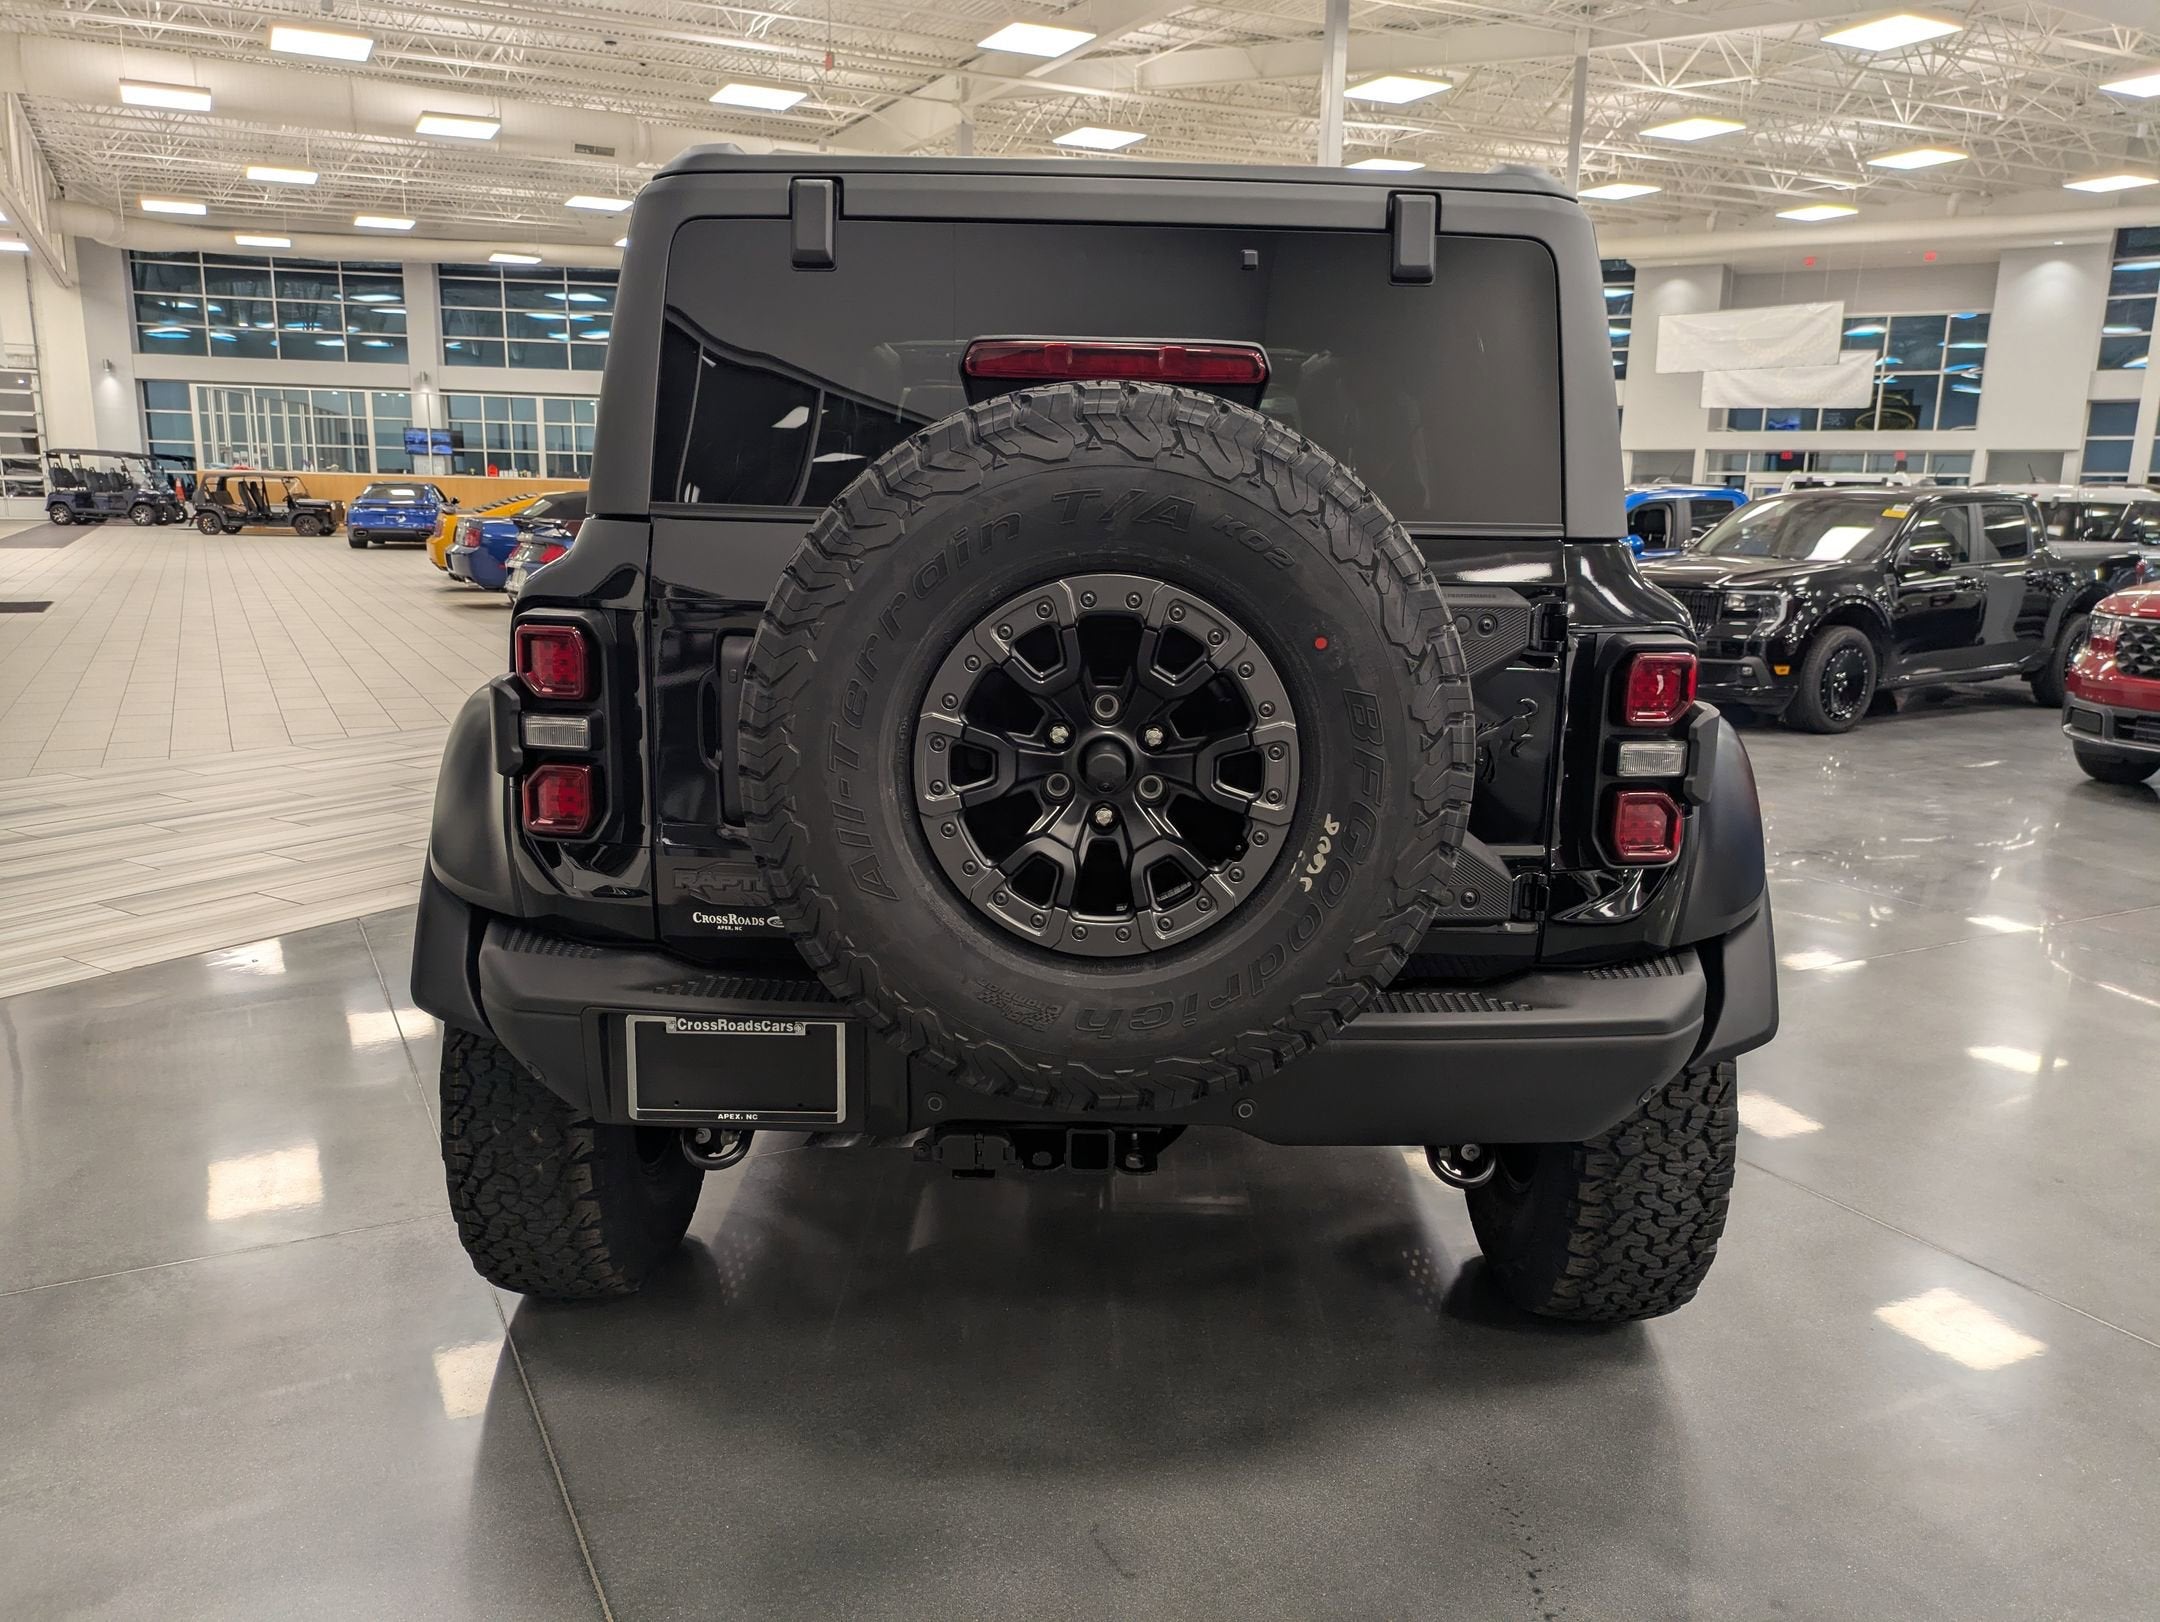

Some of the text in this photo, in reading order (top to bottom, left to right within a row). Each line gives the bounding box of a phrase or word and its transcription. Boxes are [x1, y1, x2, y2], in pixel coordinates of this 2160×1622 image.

[1051, 487, 1197, 533] T/A
[1211, 512, 1297, 570] KO2
[1074, 687, 1387, 1040] BFGoodrich
[677, 1017, 794, 1032] CrossRoadsCars
